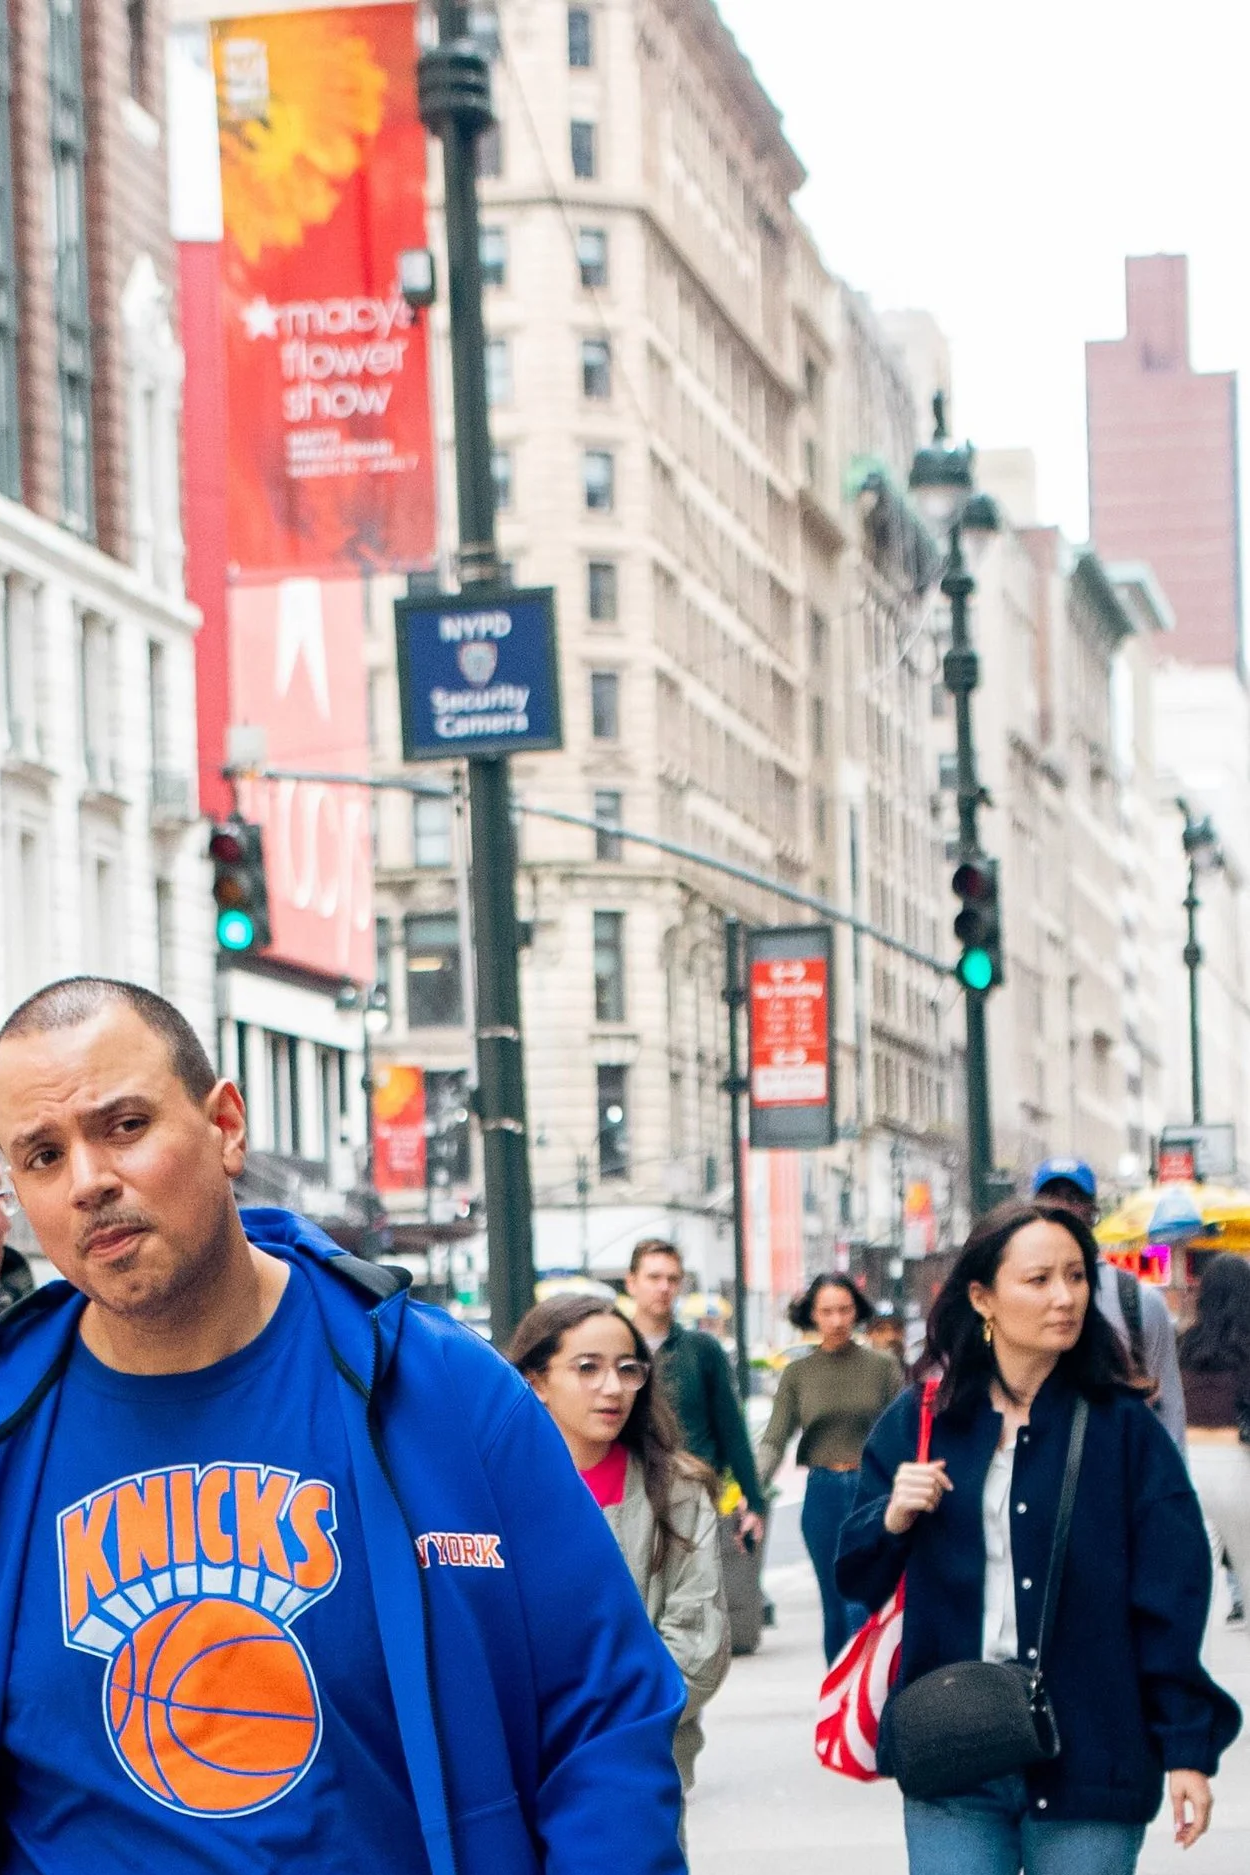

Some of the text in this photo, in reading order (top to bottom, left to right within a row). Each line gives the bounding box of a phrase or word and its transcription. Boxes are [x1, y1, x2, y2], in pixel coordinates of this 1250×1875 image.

[282, 337, 409, 379] flower
[284, 382, 393, 421] show
[438, 611, 513, 641] NYPD
[430, 682, 531, 715] Security
[435, 712, 530, 739] Camera
[59, 1464, 340, 1634] KNICKS
[428, 1531, 505, 1568] YORK
